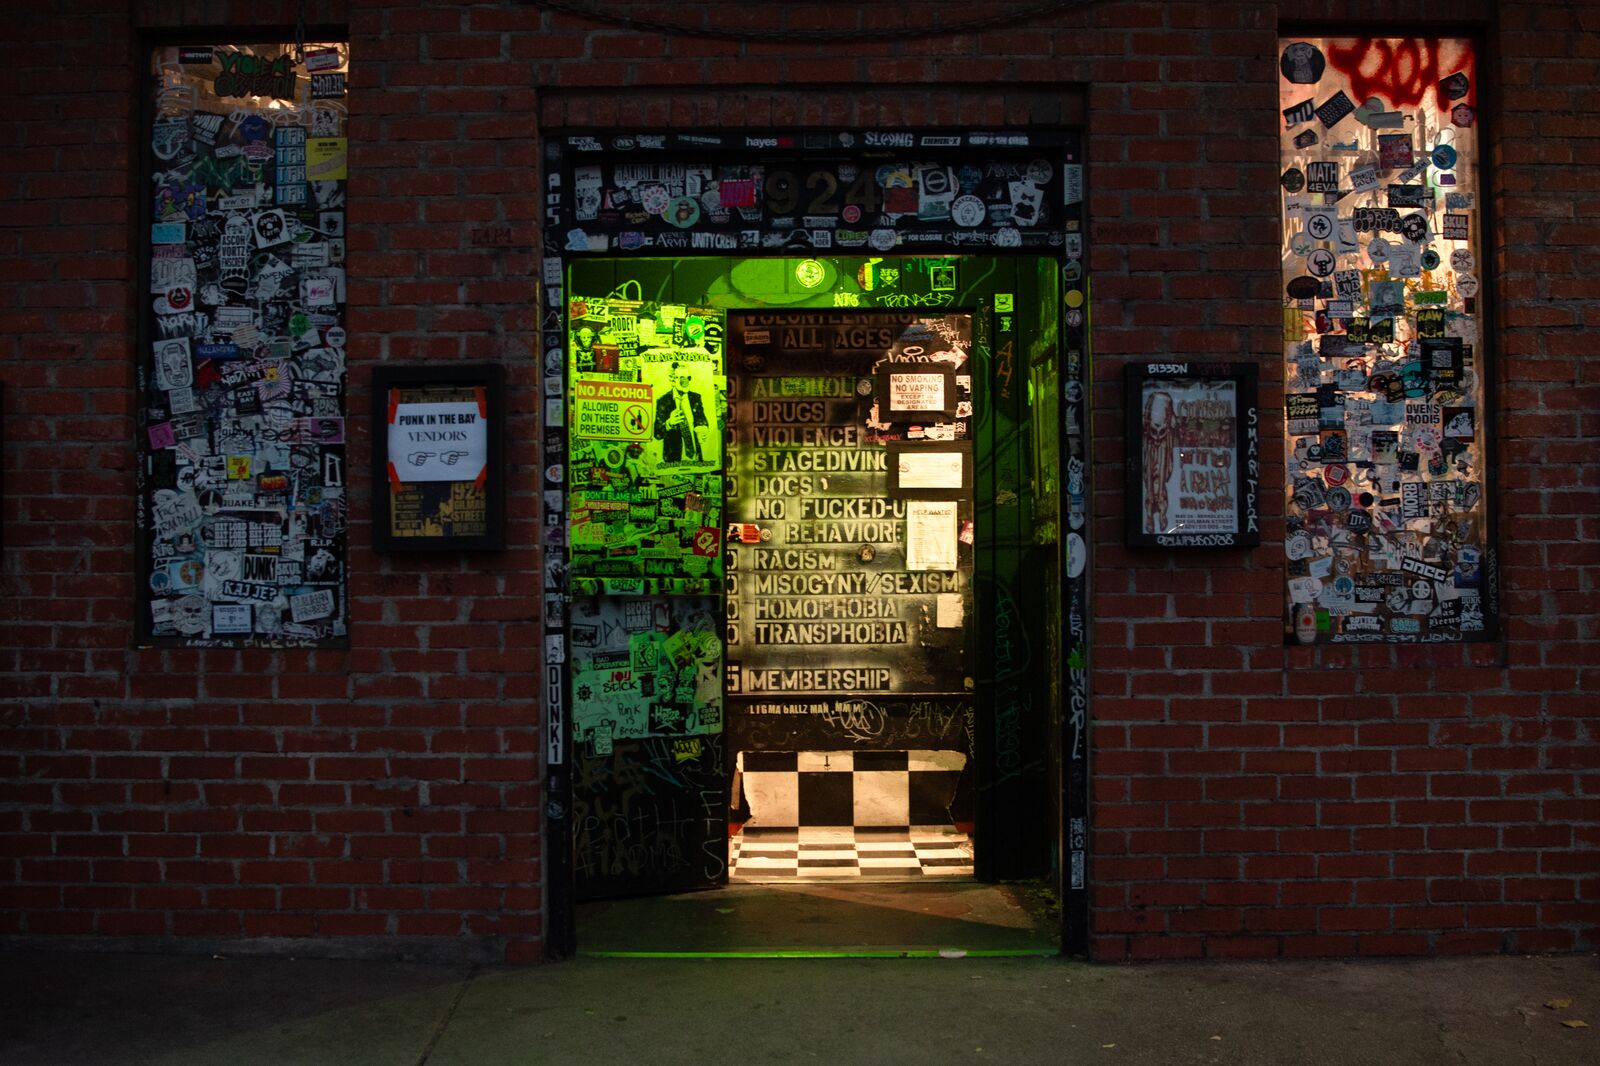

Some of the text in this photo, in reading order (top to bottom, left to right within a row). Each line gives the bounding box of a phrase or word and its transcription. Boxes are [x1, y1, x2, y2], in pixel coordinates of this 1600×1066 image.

[746, 137, 778, 149] hayes
[1308, 163, 1338, 182] MATH
[764, 169, 877, 216] 924
[1308, 182, 1338, 191] 4EVA
[1418, 310, 1444, 322] RAW
[783, 328, 893, 349] ALL AGES
[891, 375, 943, 383] NO SMOKING
[578, 384, 651, 400] NO ALCOHOL
[895, 384, 939, 392] NO VAPING
[581, 402, 619, 413] ALLOWED
[754, 402, 825, 422] DRUGS
[1406, 403, 1440, 414] OVENS
[399, 413, 477, 426] PUNK IN THE BAY
[580, 413, 620, 424] ON THESE
[408, 430, 468, 443] VENDORS
[580, 424, 621, 435] PREMISES
[754, 427, 857, 447] VIOLENCE
[754, 477, 813, 496] DOGS
[1403, 482, 1418, 517] MORB
[451, 510, 487, 521] STREET
[756, 499, 907, 519] NO FUCKED-U
[754, 550, 836, 570] RACISM
[755, 572, 959, 594] MISOGYNY/SEXISM
[755, 599, 898, 619] HOMOPHOBIA
[756, 623, 907, 644] TRANSPHOBIA
[750, 669, 889, 690] MEMBERSHIP
[750, 704, 782, 714] LIGMA
